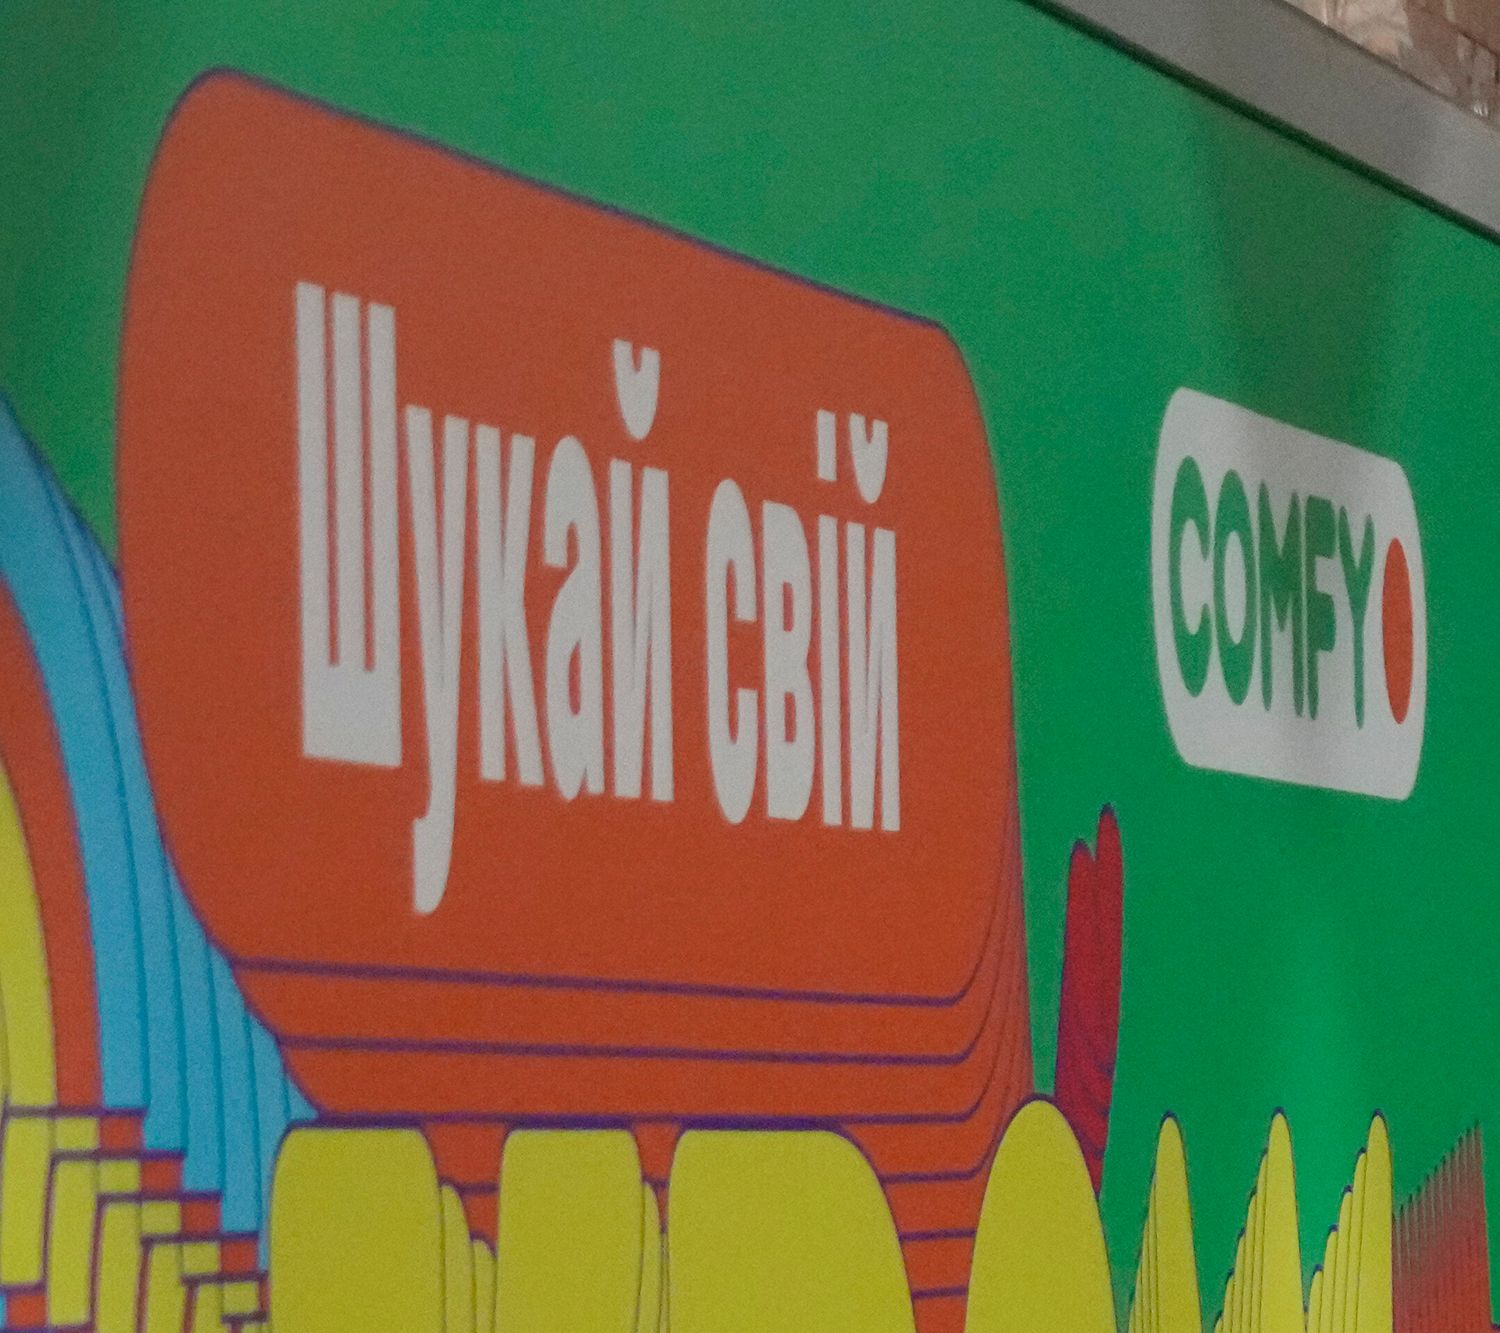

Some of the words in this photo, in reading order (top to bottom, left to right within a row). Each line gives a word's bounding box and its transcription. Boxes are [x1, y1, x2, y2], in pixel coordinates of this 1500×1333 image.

[295, 281, 676, 917] Шукай
[706, 408, 901, 834] свій
[1168, 454, 1375, 731] COMFY
